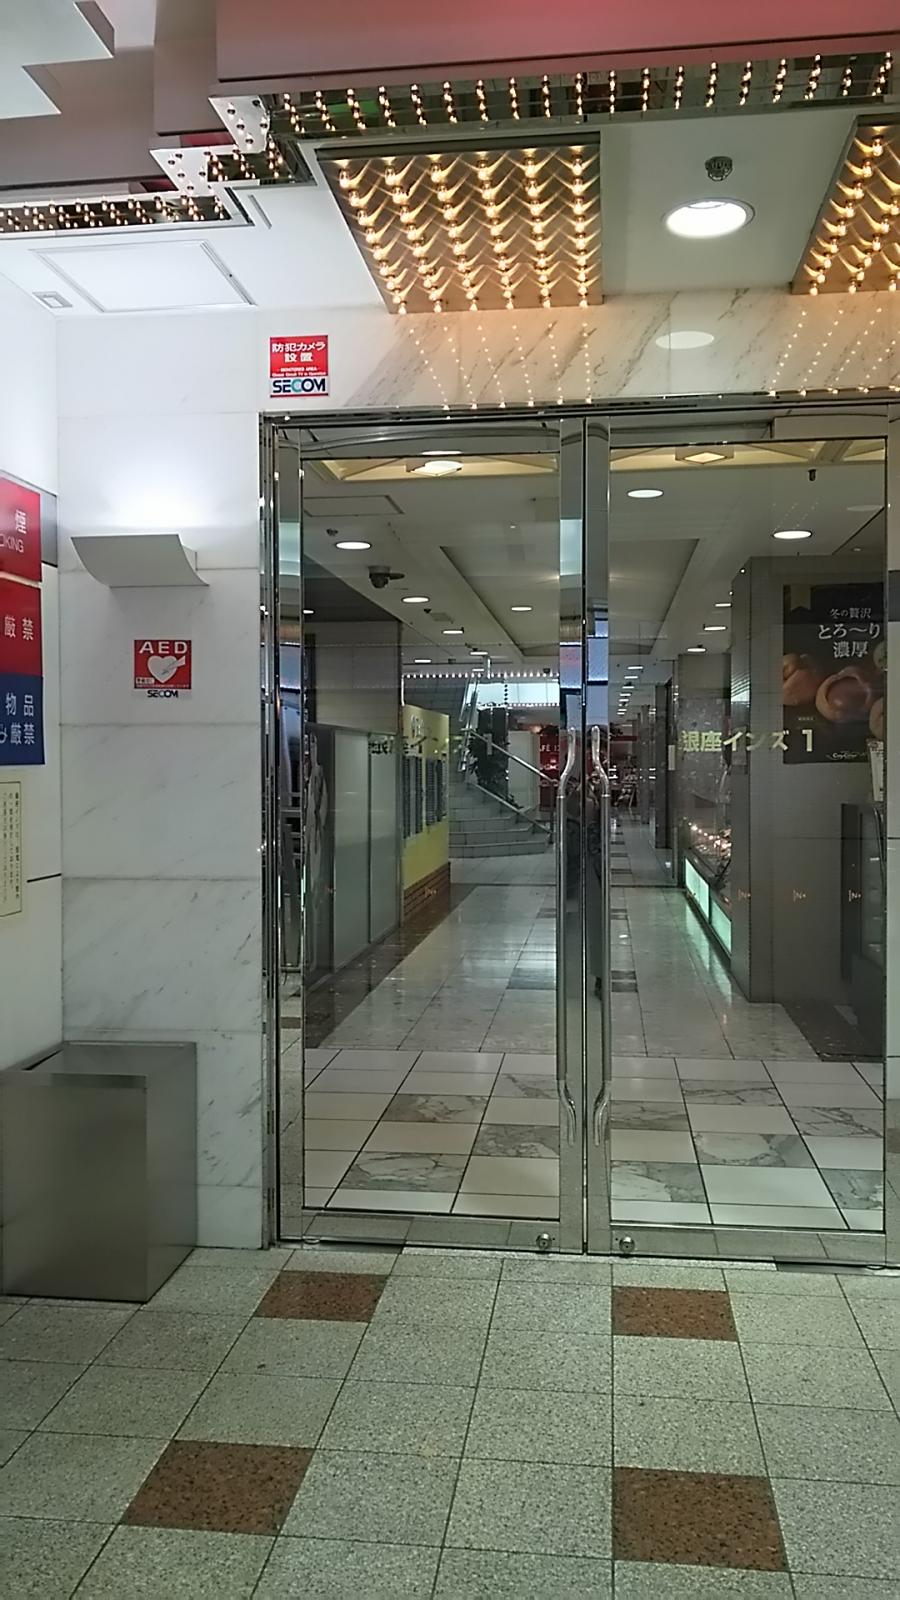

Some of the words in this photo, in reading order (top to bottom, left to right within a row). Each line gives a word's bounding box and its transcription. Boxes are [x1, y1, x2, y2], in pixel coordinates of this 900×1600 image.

[272, 341, 326, 352] 防犯カメラ
[284, 352, 313, 362] 設置
[272, 378, 326, 393] SECOM
[139, 641, 188, 654] AED
[833, 640, 868, 658] 濃厚
[147, 690, 179, 698] SECOM
[5, 692, 34, 717] 物品
[680, 730, 790, 752] 銀座インズ
